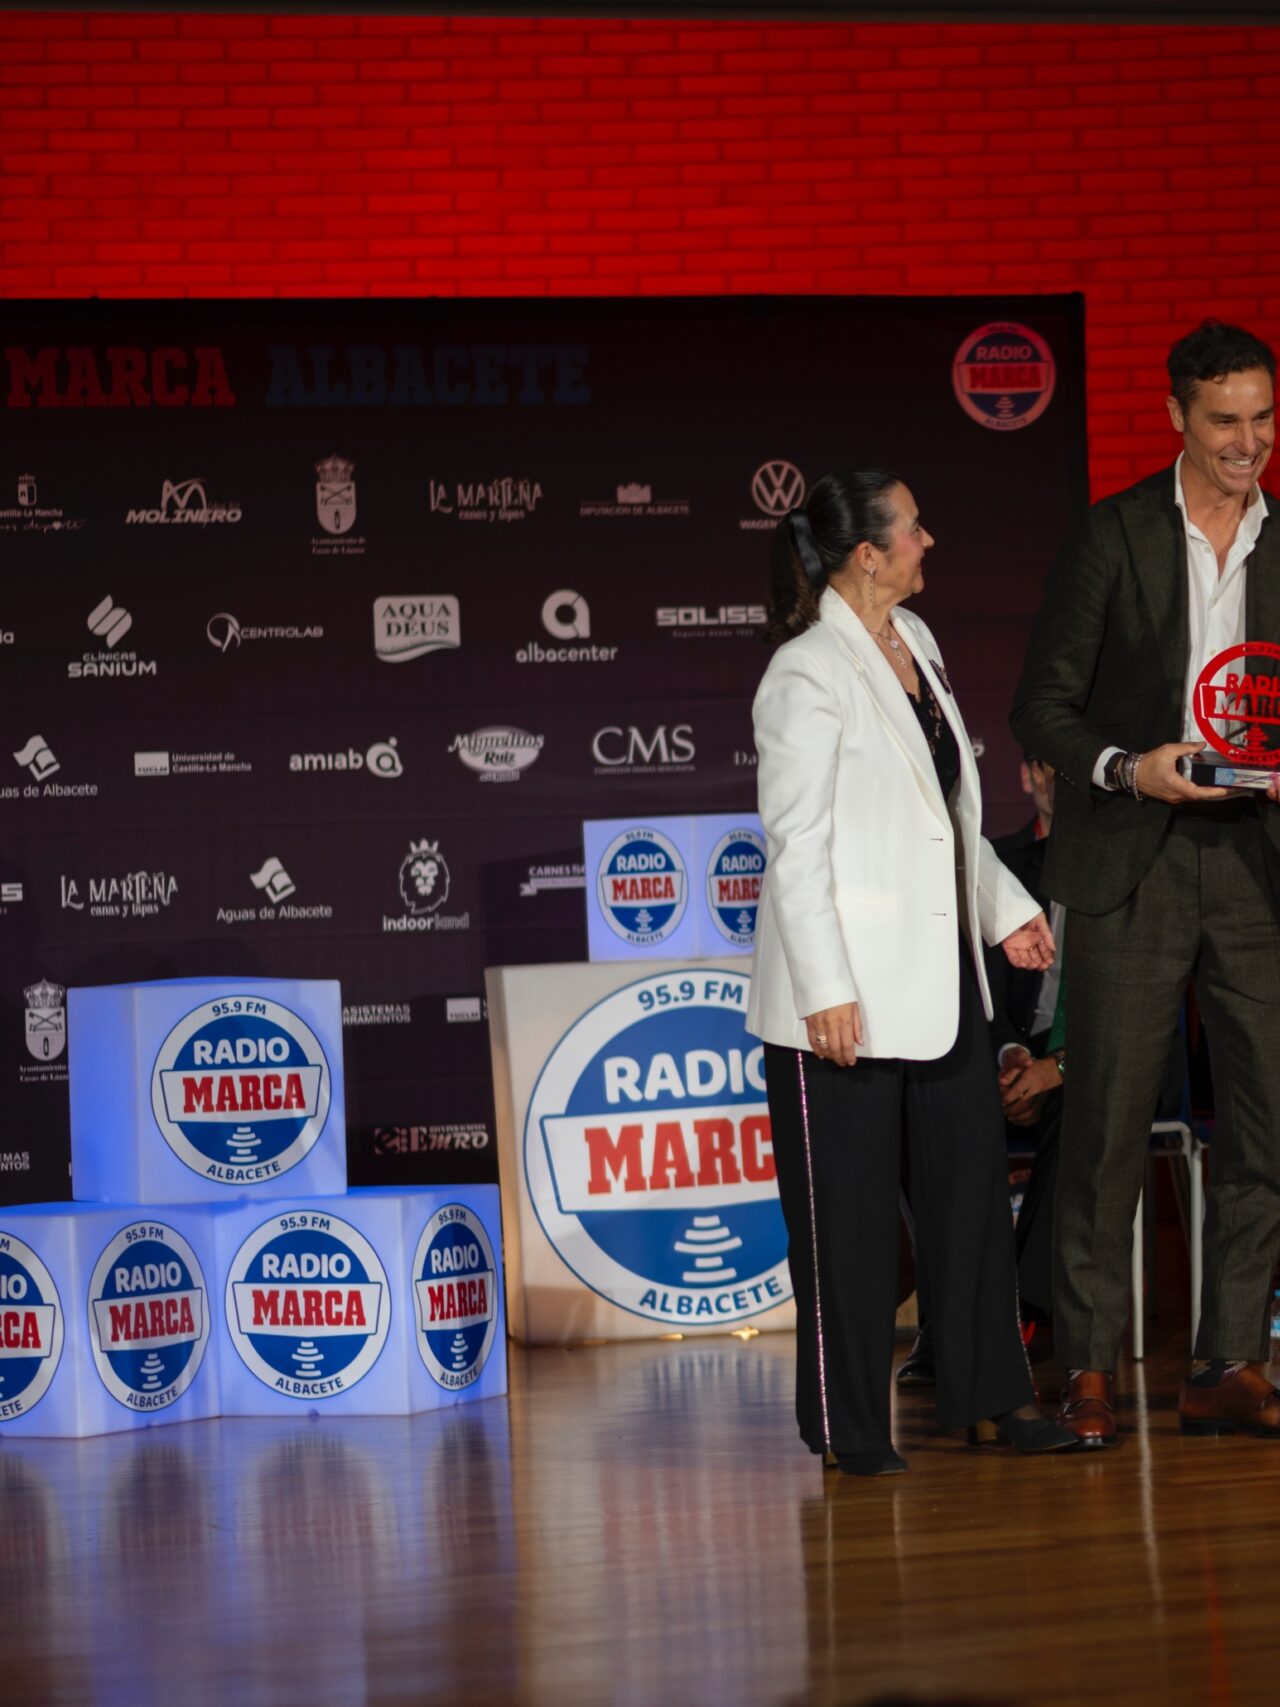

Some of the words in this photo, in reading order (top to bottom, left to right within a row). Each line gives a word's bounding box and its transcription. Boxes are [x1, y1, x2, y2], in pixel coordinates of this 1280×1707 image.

[975, 344, 1033, 361] RADIO
[4, 344, 236, 408] MARCA
[264, 344, 592, 407] ALBACETE
[969, 365, 1042, 389] MARCA
[429, 478, 454, 513] LA
[0, 508, 33, 518] astilla-La
[126, 508, 243, 524] MOLINERO
[382, 602, 451, 619] AQUA
[656, 604, 768, 627] SOLISS
[240, 626, 324, 639] CENTROLAB
[386, 620, 450, 637] DEUS
[515, 641, 619, 663] albacenter
[67, 660, 157, 678] SANIUM
[447, 731, 545, 757] Miguelitos
[591, 723, 697, 767] CMS
[171, 752, 222, 762] Universidad
[224, 751, 235, 761] de
[171, 762, 217, 773] Castilla-La
[218, 761, 252, 772] Mancha
[289, 747, 364, 772] amiab
[484, 751, 516, 766] Ruiz
[0, 786, 20, 799] uas
[23, 784, 40, 798] de
[43, 783, 98, 797] Albacete
[528, 865, 572, 877] CARNES
[616, 852, 667, 873] RADIO
[721, 853, 763, 873] RADIO
[60, 874, 85, 910] LA
[611, 875, 676, 902] MARCA
[718, 877, 763, 902] MARC
[122, 904, 129, 918] y
[132, 902, 159, 918] tapas
[216, 907, 256, 924] Aguas
[259, 906, 275, 920] de
[278, 905, 333, 919] Albacete
[382, 912, 470, 932] indoorland
[626, 931, 664, 944] ALBACETE
[729, 934, 753, 945] ALBACE
[637, 980, 695, 1010] 95.9
[704, 980, 744, 1006] FM
[212, 1001, 242, 1017] 95.9
[246, 1001, 267, 1015] FM
[192, 1036, 291, 1066] RADIO
[182, 1073, 306, 1114] MARCA
[583, 1114, 778, 1196] MARC
[206, 1160, 282, 1181] ALBACETE
[280, 1215, 308, 1231] 95.9
[311, 1216, 331, 1231] FM
[438, 1209, 454, 1224] 95.9
[455, 1208, 467, 1222] FM
[125, 1226, 147, 1243] 95.9
[149, 1226, 164, 1240] FM
[261, 1252, 352, 1279] RADIO
[430, 1243, 480, 1275] RADIO
[115, 1261, 182, 1293] RADIO
[428, 1278, 488, 1322] MARCA
[638, 1276, 784, 1316] ALBACETE
[252, 1290, 367, 1326] MARCA
[109, 1297, 195, 1342] MARCA
[275, 1376, 345, 1395] ALBACETE
[439, 1368, 479, 1386] ALBACETE
[126, 1385, 178, 1408] ALBACETE
